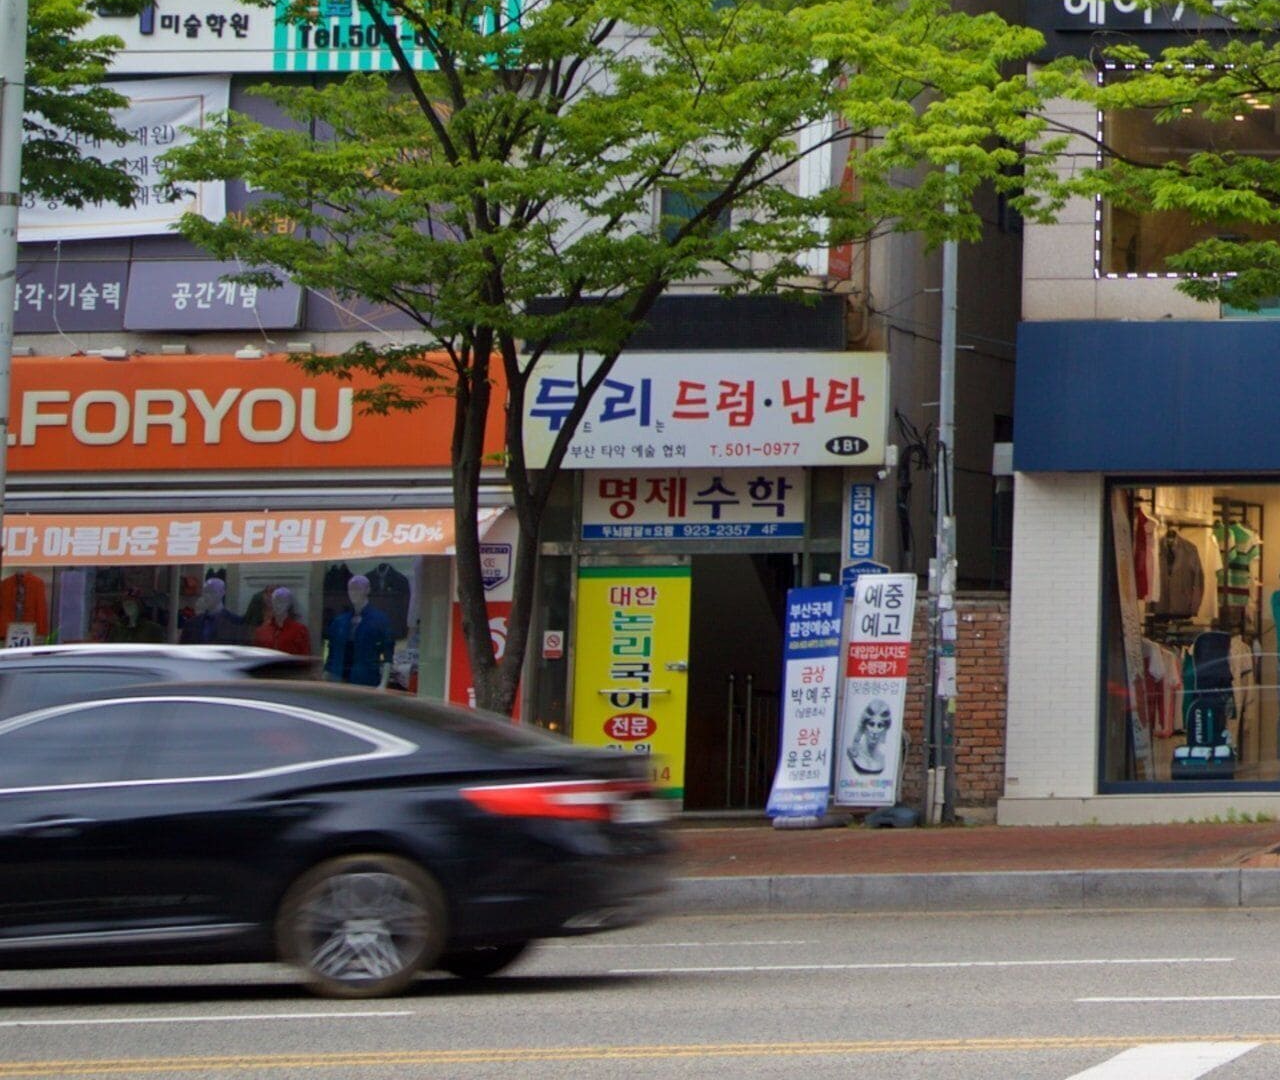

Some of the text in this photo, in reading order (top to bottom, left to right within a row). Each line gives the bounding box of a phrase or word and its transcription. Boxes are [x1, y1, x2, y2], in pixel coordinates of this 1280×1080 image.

[161, 13, 250, 39] 미술학원
[530, 378, 652, 431] 두리
[842, 439, 861, 453] B1
[599, 476, 793, 520] 명제수학
[43, 525, 158, 557] 아름다운
[166, 520, 201, 557] 봄
[208, 517, 324, 556] 스타일!
[683, 524, 751, 539] 923-2357
[761, 523, 778, 537] 4F
[610, 587, 657, 607] 대한
[864, 584, 904, 610] 예중
[860, 613, 902, 639] 예고
[801, 666, 825, 685] 금상
[612, 717, 650, 737] 전문
[797, 727, 821, 747] 은상
